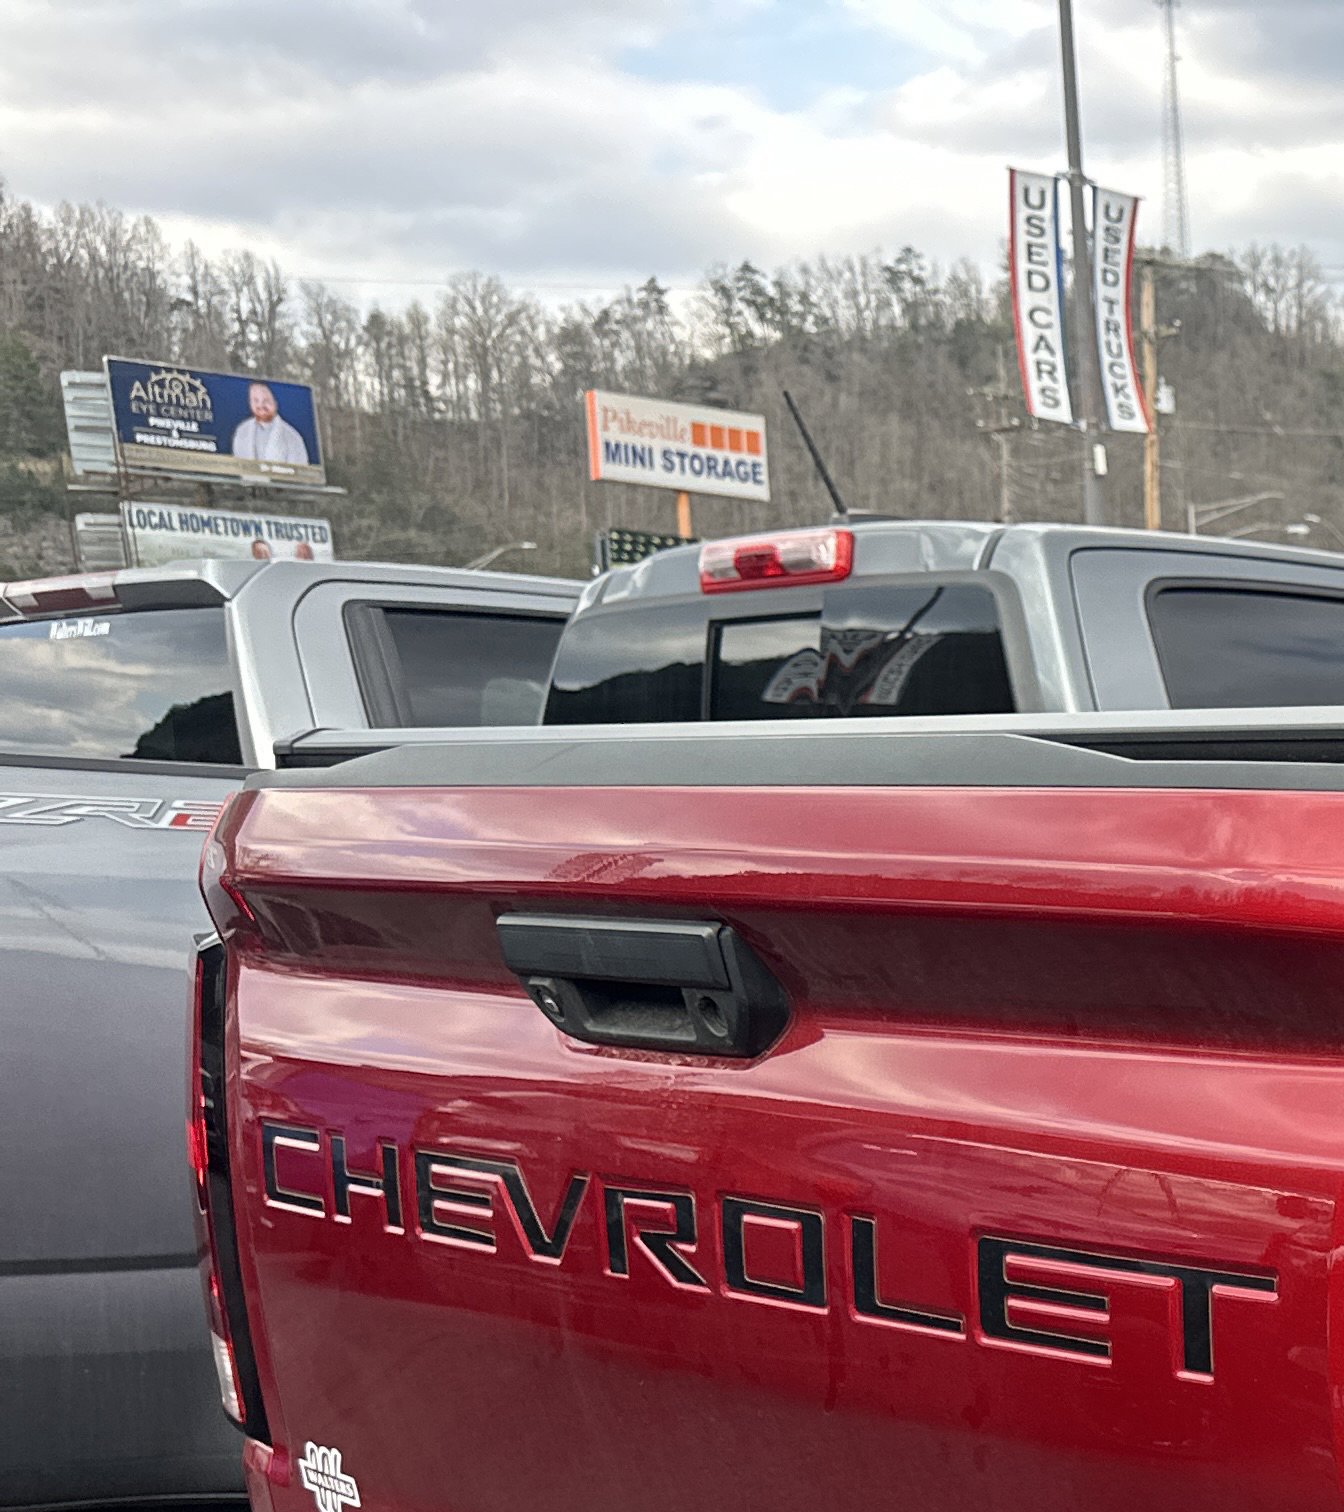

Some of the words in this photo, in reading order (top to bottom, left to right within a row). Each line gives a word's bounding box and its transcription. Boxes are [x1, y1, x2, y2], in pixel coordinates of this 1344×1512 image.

[1023, 187, 1050, 292] USED
[1101, 203, 1124, 288] USED
[1028, 307, 1062, 410] CARS
[1103, 299, 1136, 421] TRUCKS
[604, 441, 654, 472] MINI
[660, 449, 765, 486] STORAGE
[128, 510, 176, 531] LOCAL
[179, 512, 263, 539] HOMETOWN
[266, 520, 329, 544] TRUSTED
[261, 1120, 1280, 1385] CHEVROLET
